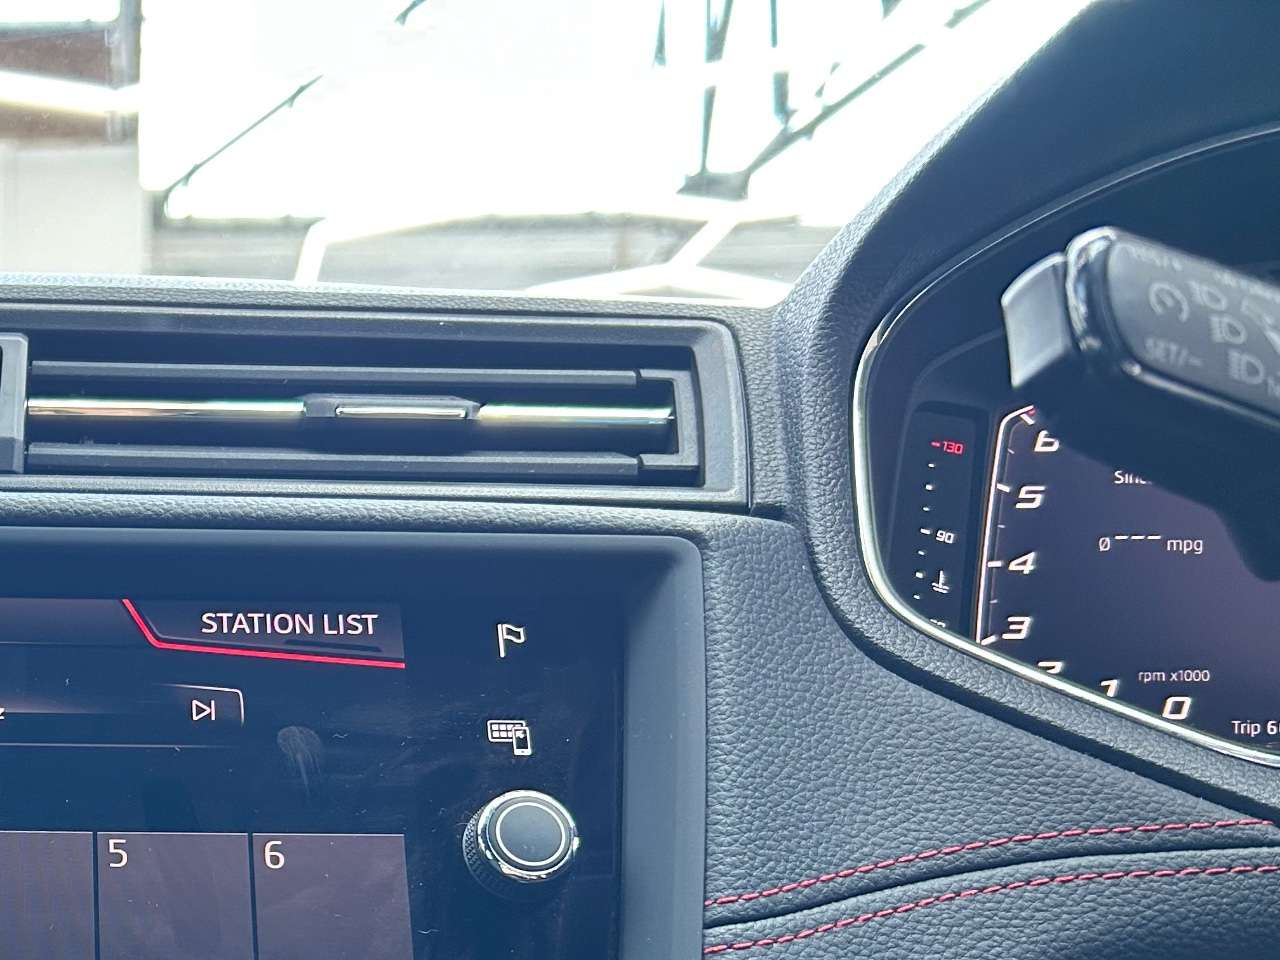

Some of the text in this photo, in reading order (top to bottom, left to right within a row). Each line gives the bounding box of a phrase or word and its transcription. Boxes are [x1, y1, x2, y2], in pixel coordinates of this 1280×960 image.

[943, 440, 964, 455] 130
[1033, 430, 1060, 453] 6
[1015, 485, 1046, 509] 5
[935, 529, 955, 544] 90
[1166, 539, 1203, 555] mpg
[1008, 551, 1036, 575] 4
[201, 612, 379, 635] STATION LIST
[1001, 616, 1033, 640] 3
[1138, 669, 1211, 684] rpm x1000
[1162, 696, 1192, 720] 0
[1231, 720, 1261, 738] Trip
[108, 838, 128, 868] 5
[264, 840, 285, 869] 6
